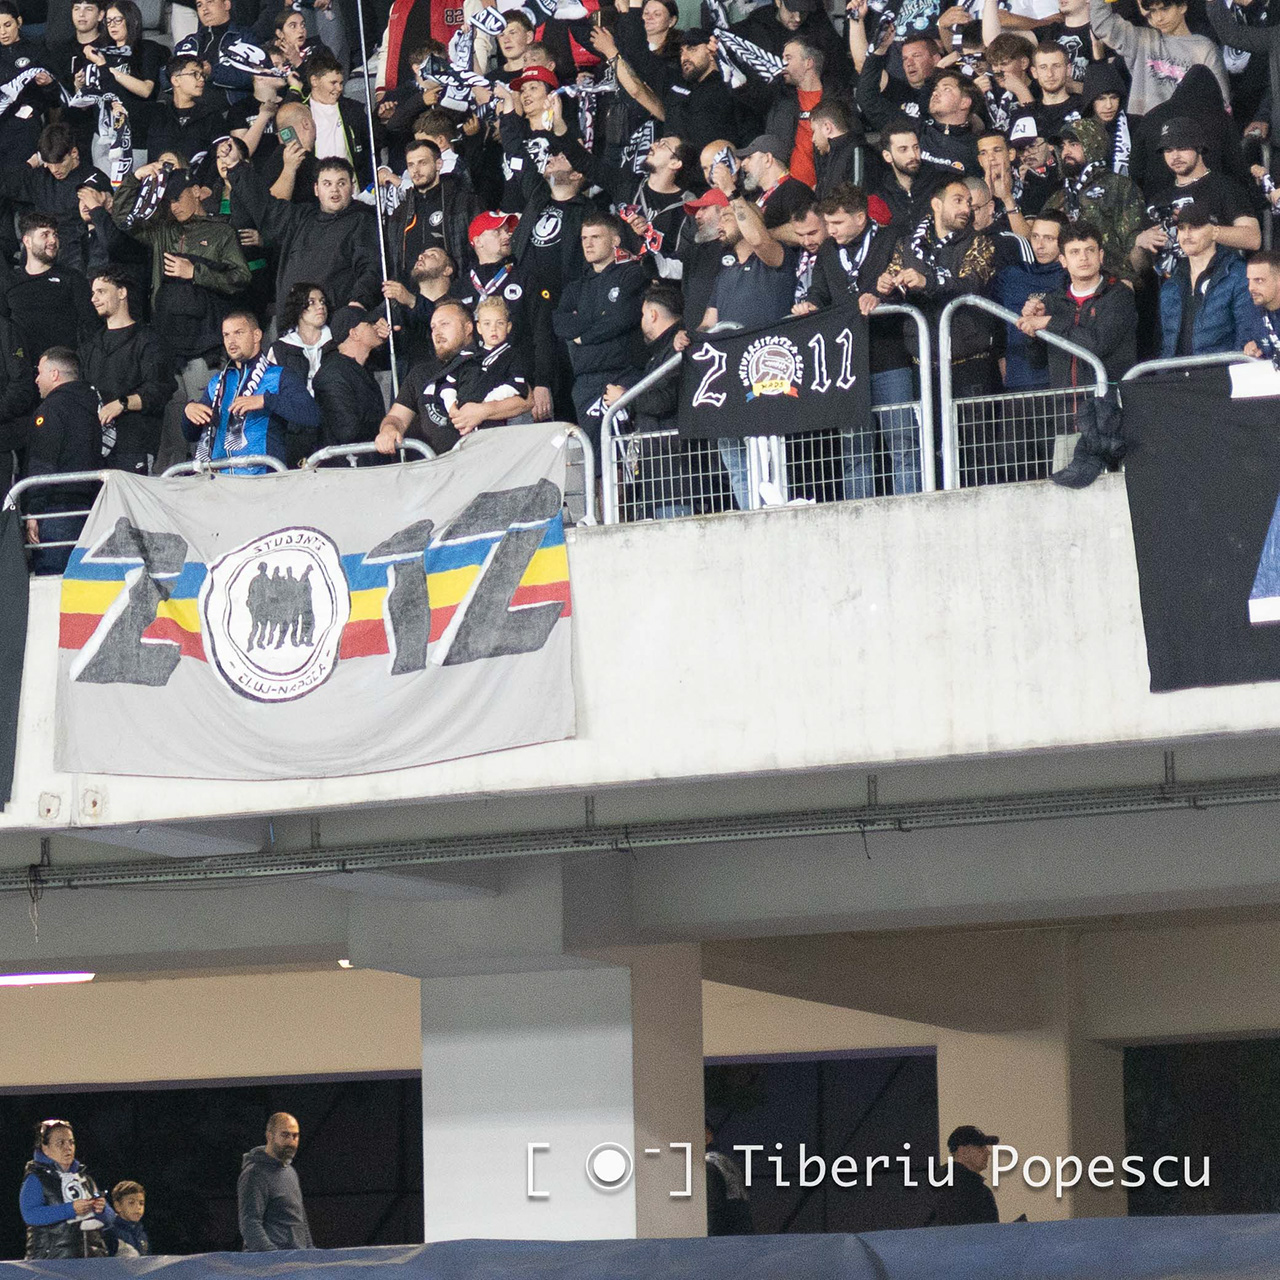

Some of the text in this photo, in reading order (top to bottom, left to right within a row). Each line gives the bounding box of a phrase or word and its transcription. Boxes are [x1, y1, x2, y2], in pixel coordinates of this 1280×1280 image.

[921, 150, 951, 166] llesse
[807, 327, 858, 393] 11
[72, 476, 568, 687] 2 12
